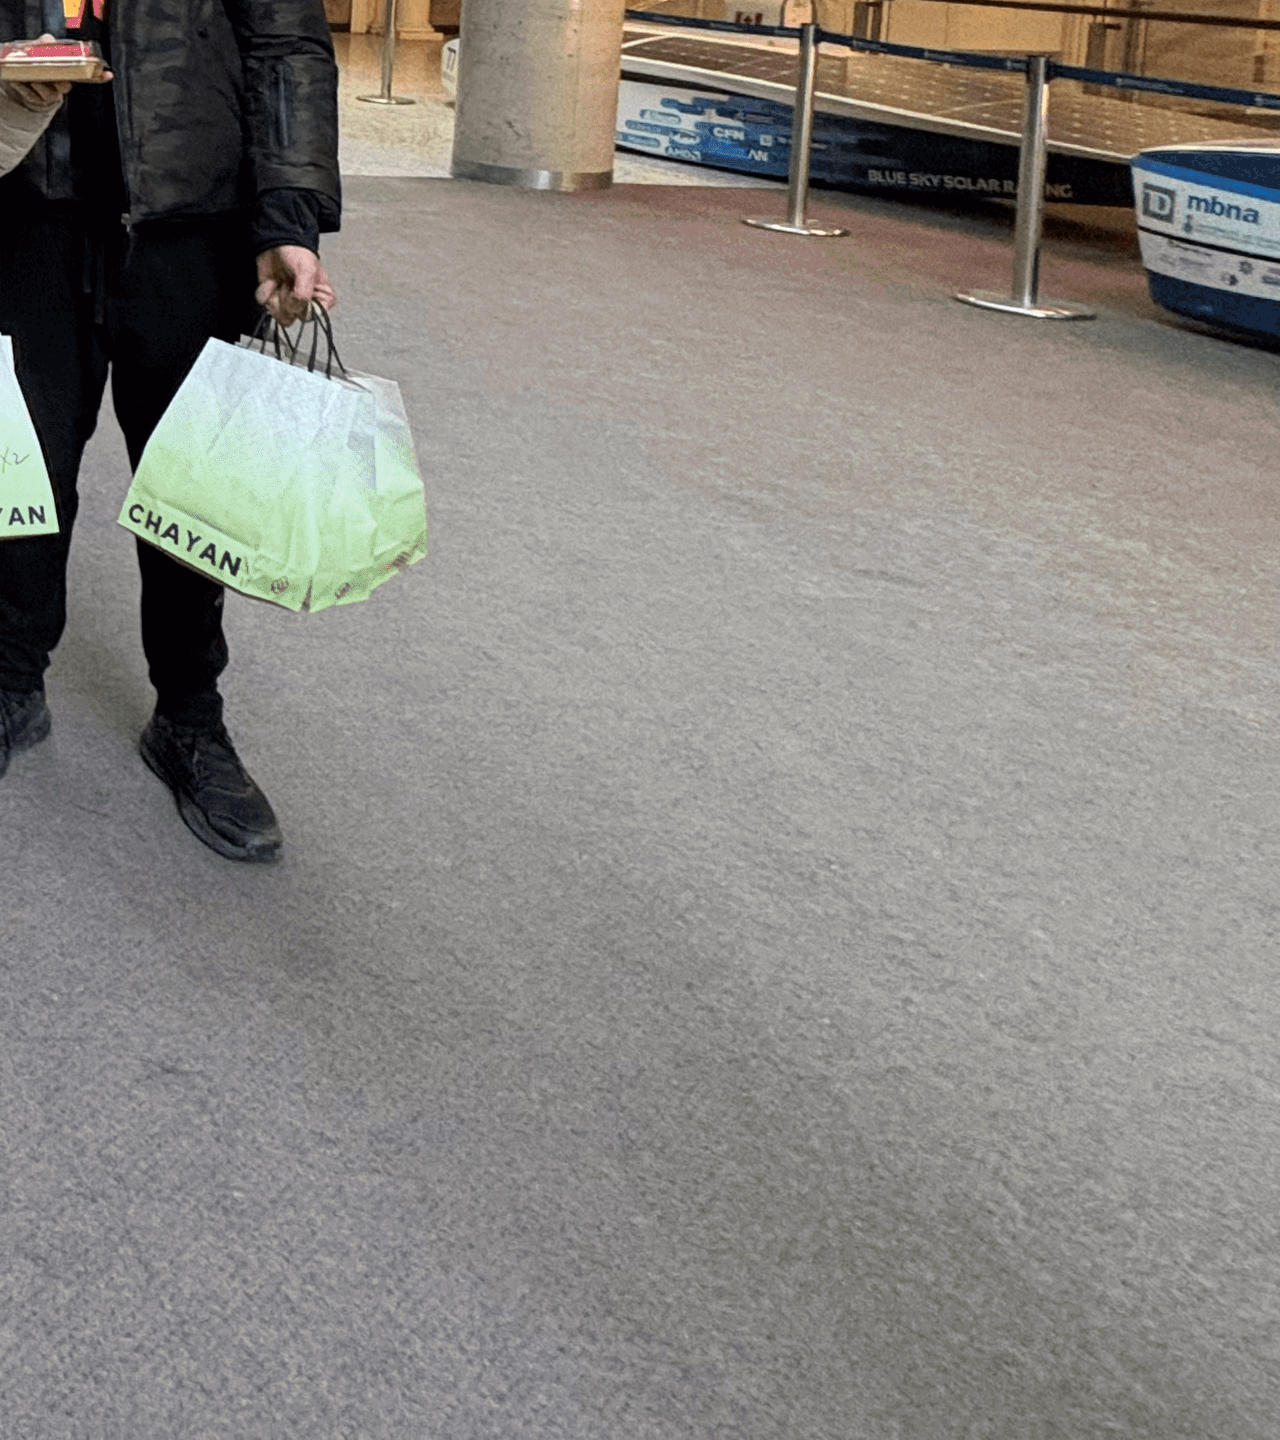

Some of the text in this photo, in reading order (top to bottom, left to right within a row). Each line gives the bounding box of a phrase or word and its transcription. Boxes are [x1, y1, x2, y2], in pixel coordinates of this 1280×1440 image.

[867, 169, 1074, 200] BLUE SKY SOLAR RNG
[1188, 195, 1260, 226] mbna
[128, 503, 243, 578] CHAYAN
